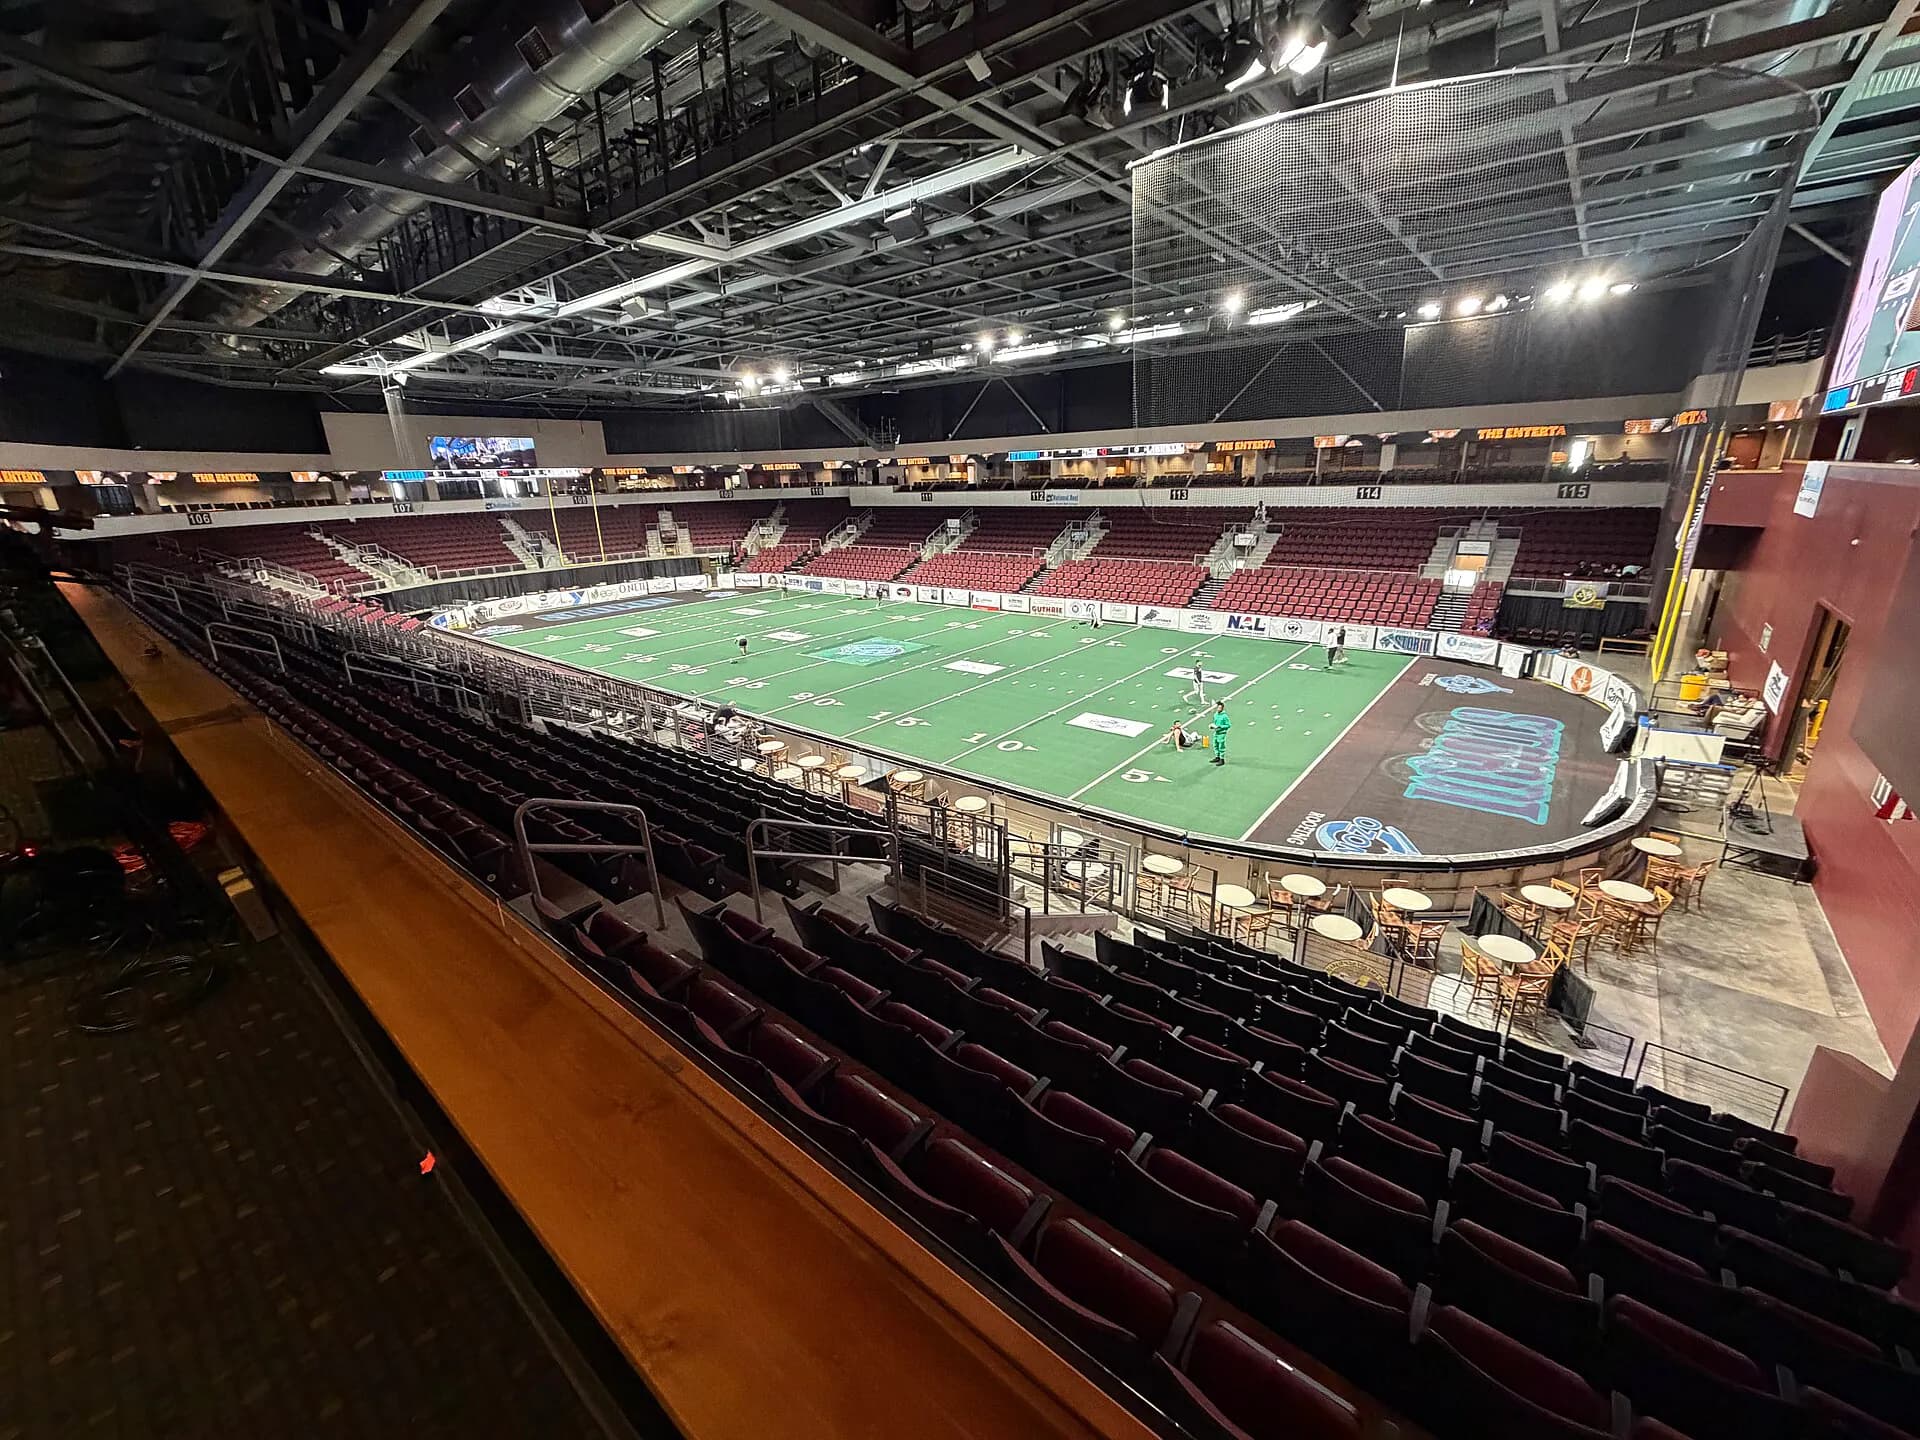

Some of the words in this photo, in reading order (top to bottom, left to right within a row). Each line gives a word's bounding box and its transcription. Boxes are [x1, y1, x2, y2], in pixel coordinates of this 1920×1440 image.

[1478, 428, 1504, 440] THE
[1504, 425, 1567, 439] ENTERTA
[1216, 441, 1233, 451] THE
[1234, 439, 1276, 450] ENTERTA
[191, 473, 216, 483] THE
[720, 490, 733, 498] 109
[921, 493, 932, 501] 111
[1031, 492, 1044, 501] 112
[1171, 490, 1188, 499] 113
[1358, 488, 1380, 499] 114
[1560, 485, 1588, 498] 115
[394, 503, 412, 513] 107
[189, 513, 211, 525] 106
[1031, 605, 1063, 614] GUTHRIE
[1227, 615, 1266, 631] NAL
[1395, 635, 1433, 653] STORM
[1120, 768, 1154, 783] 5
[1286, 811, 1326, 846] ROOFING
